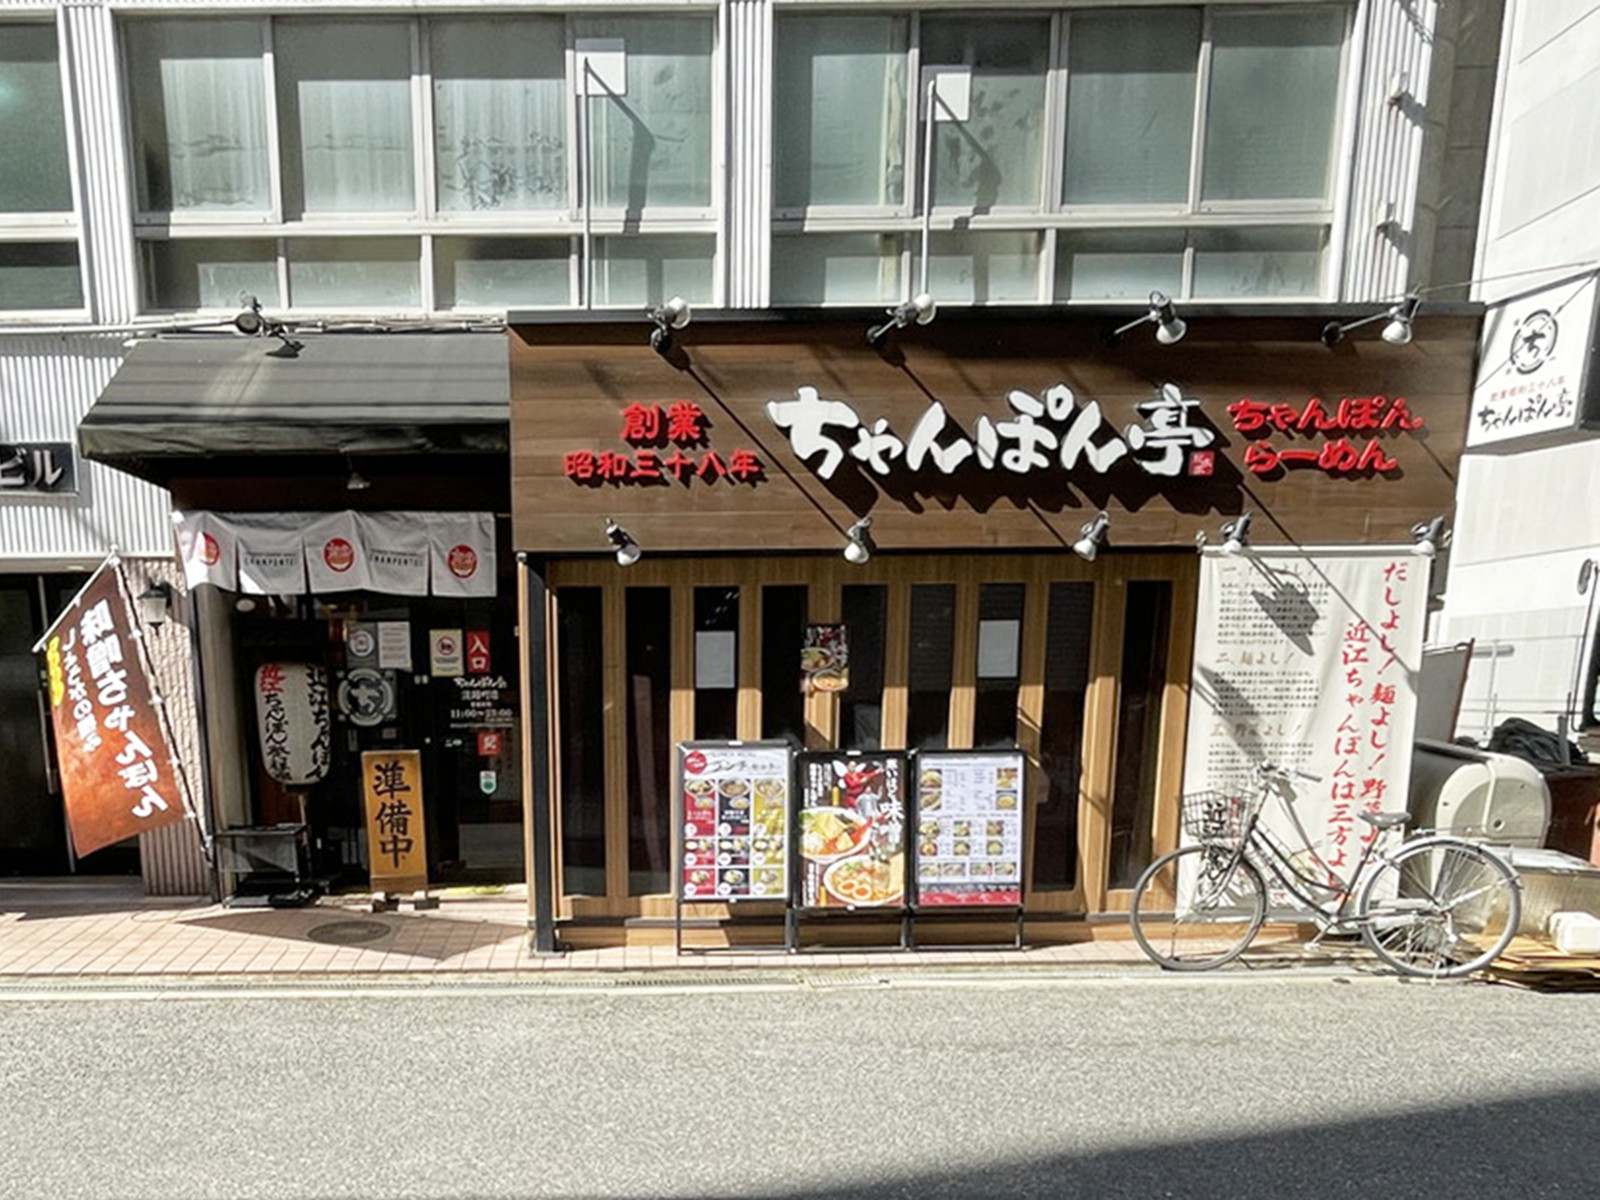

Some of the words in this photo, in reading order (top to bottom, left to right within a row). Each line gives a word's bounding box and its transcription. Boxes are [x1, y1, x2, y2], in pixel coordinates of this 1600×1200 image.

[621, 401, 703, 442] 創業
[766, 385, 1214, 478] ちゃんぽん亭
[1226, 394, 1424, 434] ちゃんぽん
[563, 449, 762, 481] 昭和三十八年
[1243, 438, 1399, 476] らーめん
[471, 633, 489, 670] 入口
[373, 760, 413, 869] 準備中
